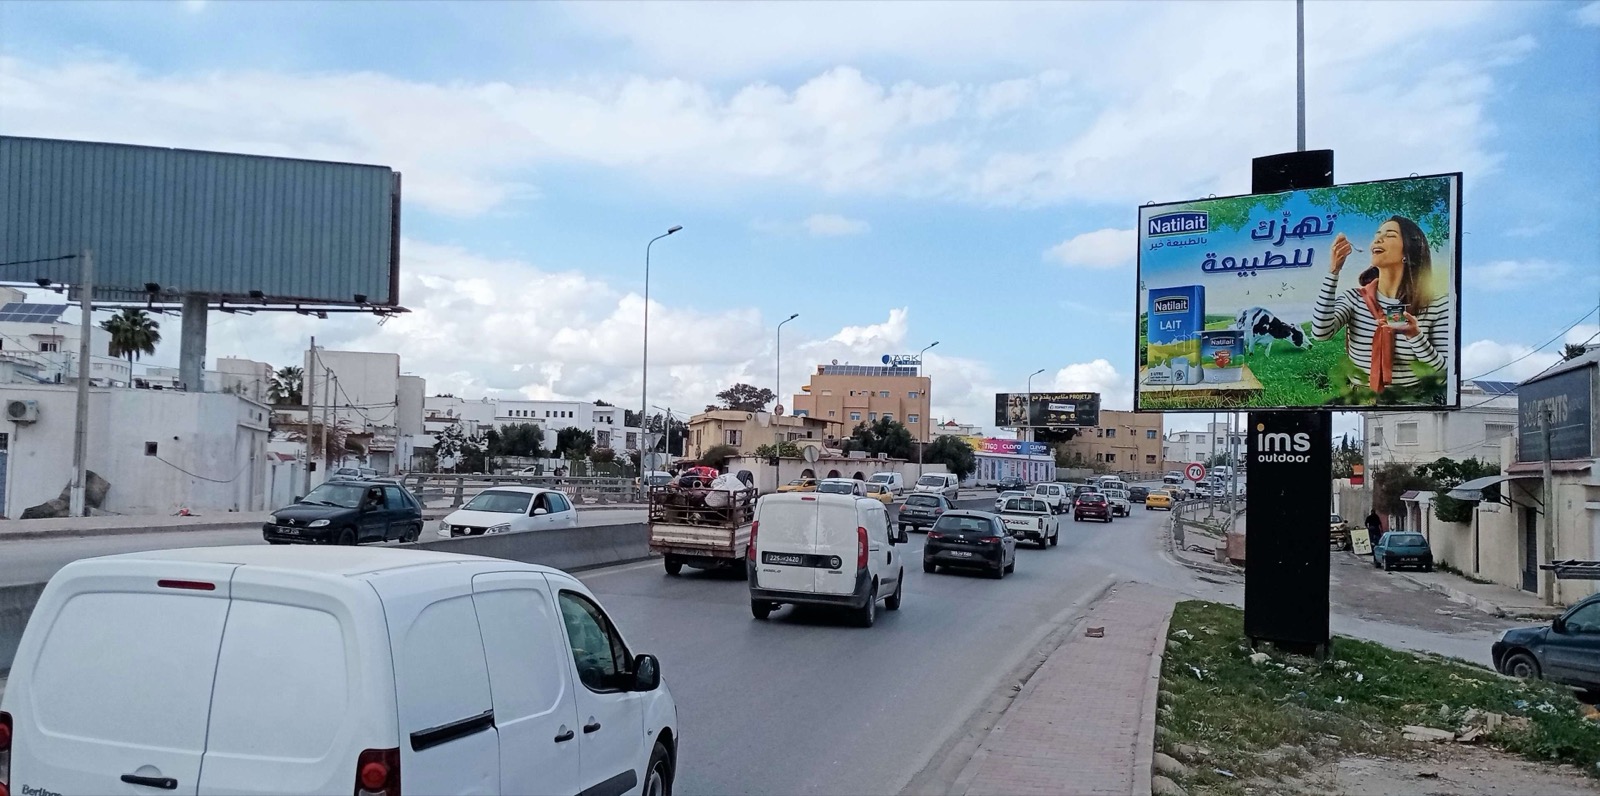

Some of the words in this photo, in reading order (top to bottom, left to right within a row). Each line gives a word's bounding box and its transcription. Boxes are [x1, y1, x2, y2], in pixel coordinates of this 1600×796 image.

[1150, 215, 1206, 234] Natilait
[1149, 240, 1164, 251] خير
[1166, 237, 1208, 249] بالطبيعة
[1201, 248, 1315, 277] للطبيعة
[1155, 300, 1188, 312] Natilait
[1160, 320, 1182, 330] LAIT
[1257, 423, 1311, 452] ims
[1258, 453, 1311, 463] outdoor
[1191, 468, 1202, 477] 70
